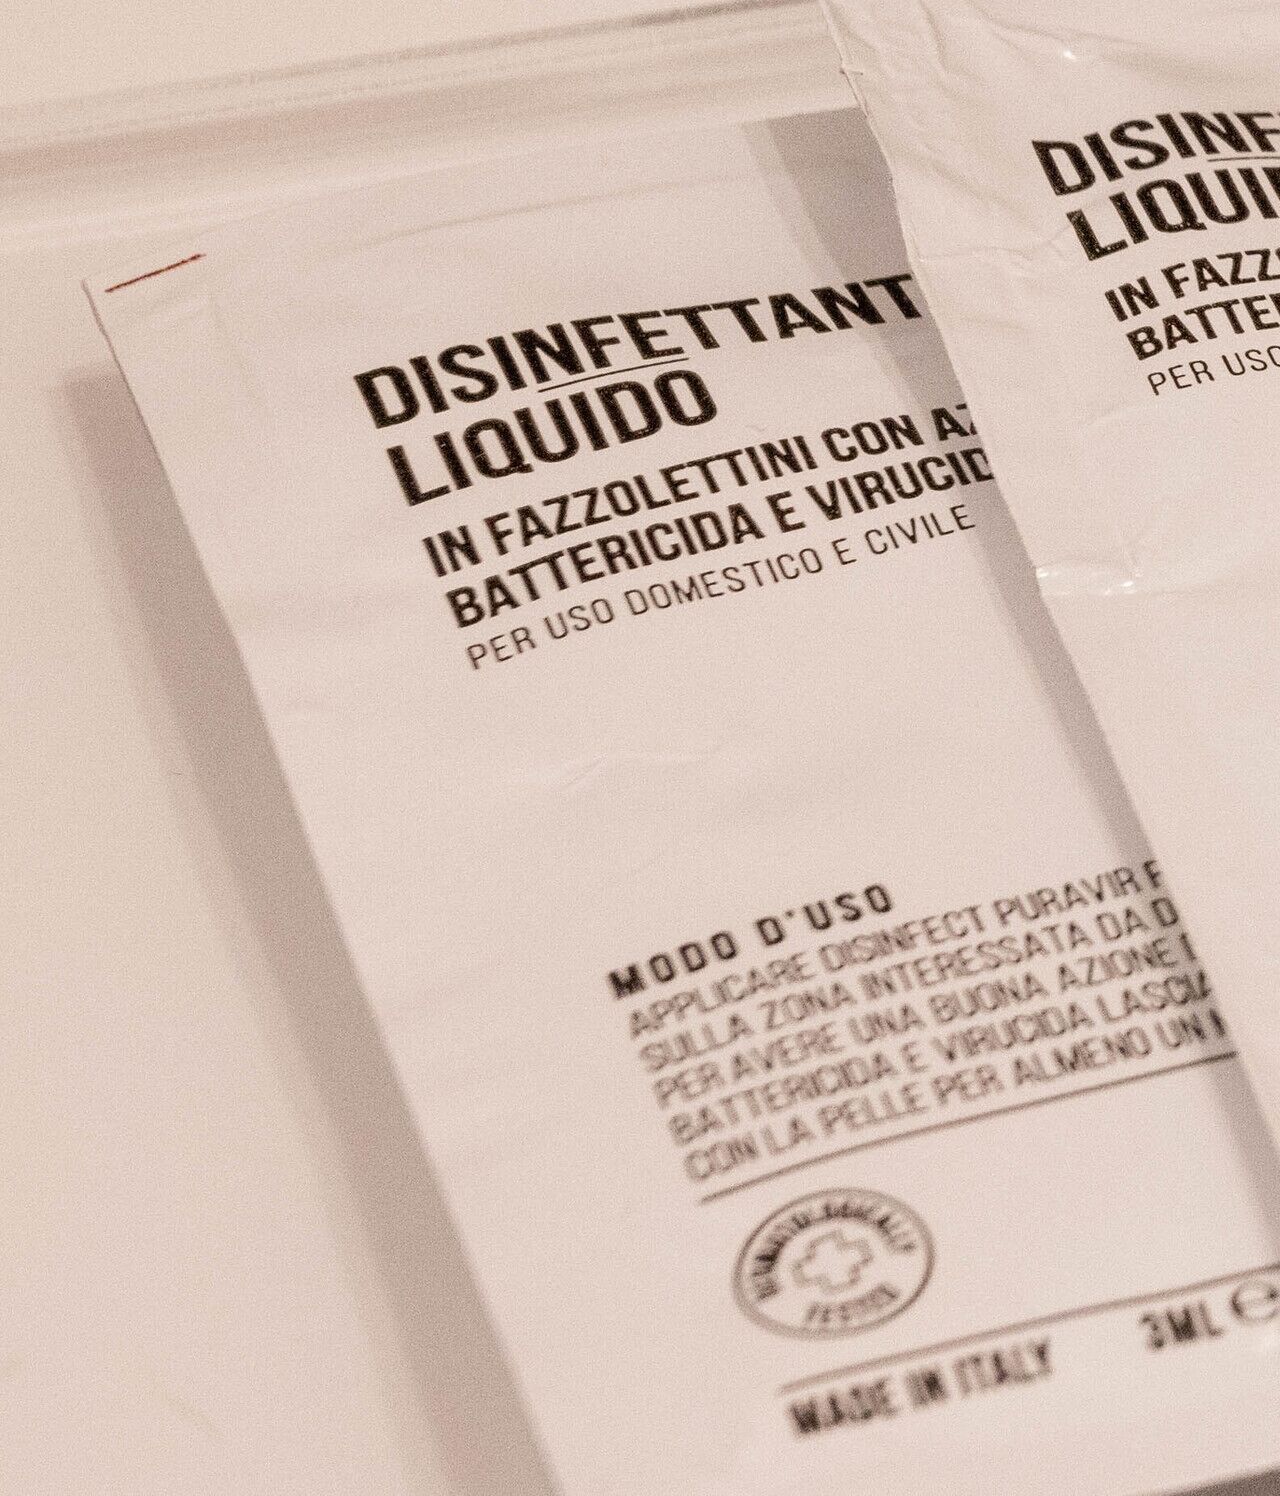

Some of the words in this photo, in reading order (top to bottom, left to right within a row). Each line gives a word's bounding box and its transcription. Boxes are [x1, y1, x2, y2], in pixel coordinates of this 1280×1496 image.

[353, 271, 922, 428] DISINFETTANT
[1104, 274, 1157, 321] IN
[387, 369, 717, 507] LIQUIDO
[1147, 360, 1216, 396] PER
[423, 526, 481, 577] IN
[484, 434, 817, 558] FAZZOLETTINI
[821, 414, 922, 464] CON
[445, 503, 763, 628] BATTERICIDA
[774, 491, 806, 532] E
[466, 627, 537, 671] PER
[545, 598, 614, 639] USO
[623, 545, 823, 615] DOMESTICO
[835, 537, 856, 564] E
[865, 504, 975, 557] CIVILE
[607, 930, 740, 1000] MODO
[755, 882, 894, 946] D'USO
[629, 952, 809, 1039] APPLICARE
[639, 1017, 750, 1073] SULLA
[759, 982, 852, 1032] ZONA
[860, 924, 1092, 1002] INTERESSATA
[652, 1057, 725, 1109] PER
[730, 1028, 844, 1084] AVERE
[848, 1002, 924, 1046] UNA
[928, 974, 1044, 1023] BUONA
[683, 1132, 759, 1182] CON
[819, 1083, 928, 1137] PELLE
[933, 1064, 1005, 1107] PER
[953, 1336, 1053, 1397] ITALY
